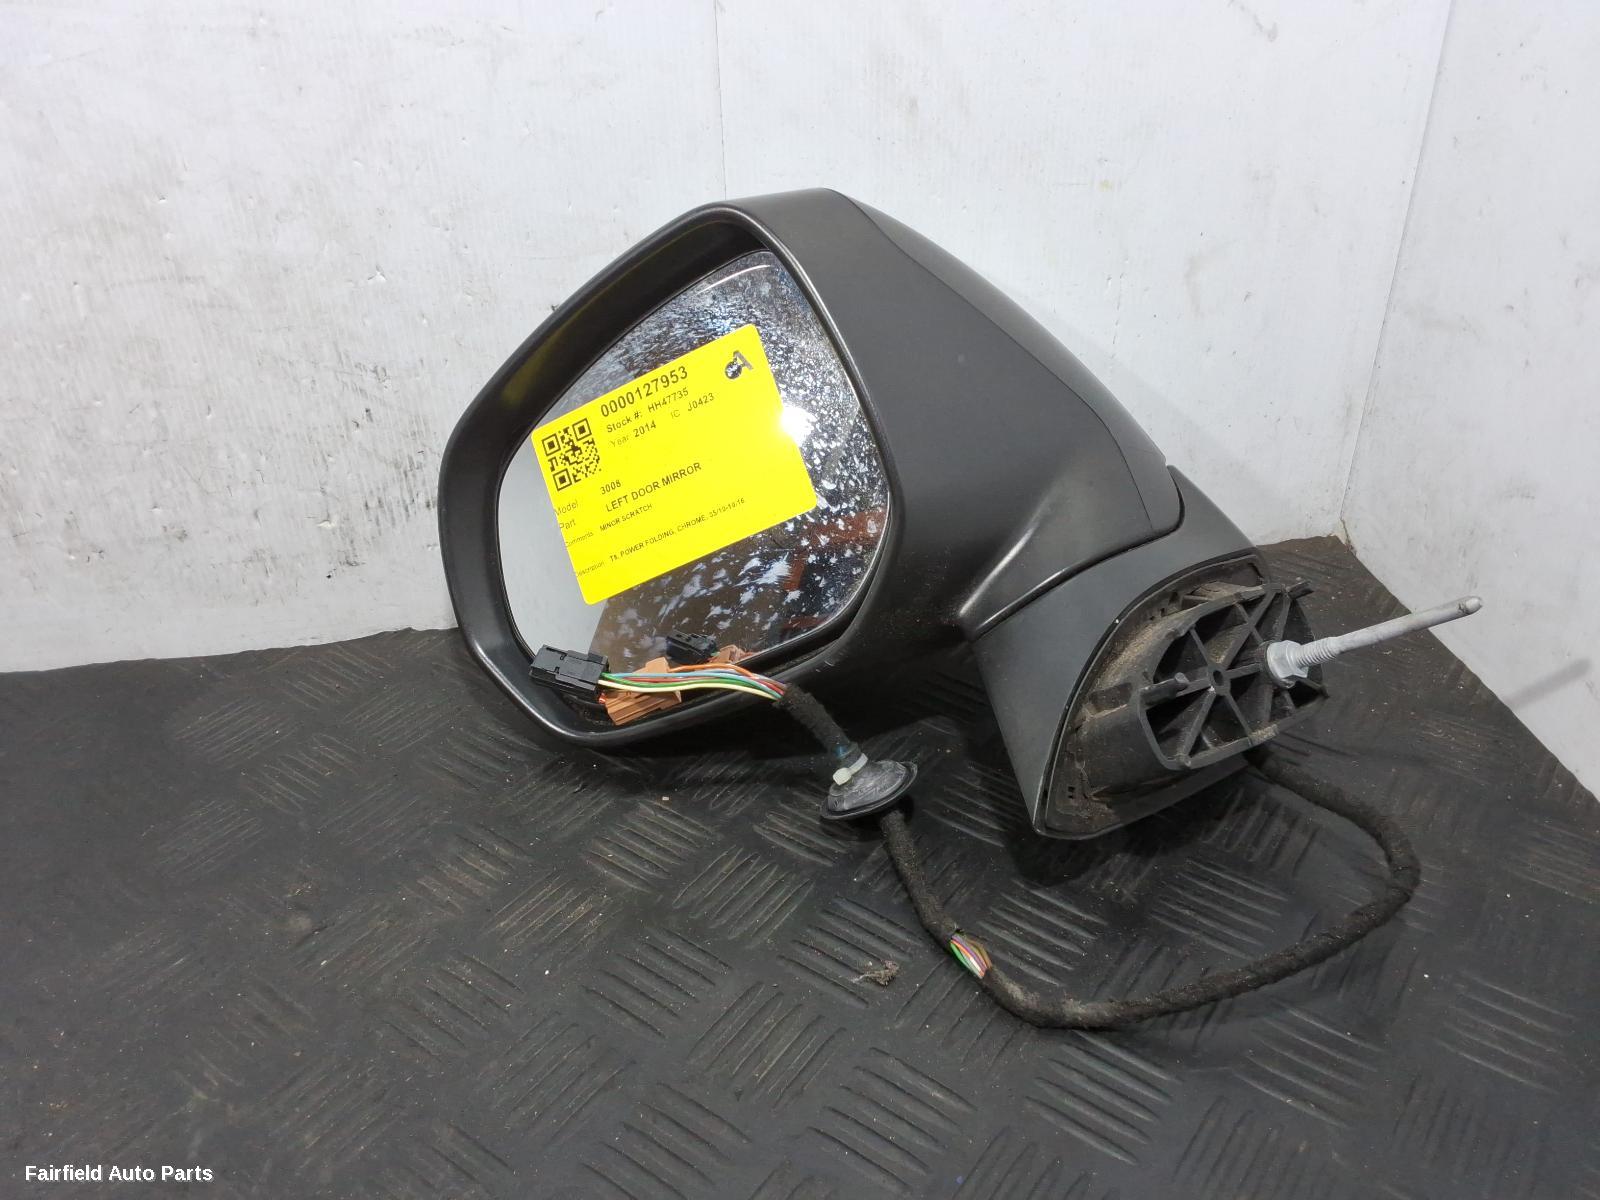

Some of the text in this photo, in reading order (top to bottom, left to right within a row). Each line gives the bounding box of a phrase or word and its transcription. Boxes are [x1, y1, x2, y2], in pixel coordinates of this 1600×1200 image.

[600, 366, 688, 417] 0000127953
[606, 416, 632, 433] Stock
[647, 387, 689, 413] HH47735
[633, 420, 657, 438] 2014
[687, 392, 715, 412] J0423
[600, 479, 622, 495] 3008
[606, 494, 629, 512] LEFT
[631, 481, 660, 500] DOOR
[661, 462, 702, 487] MIRROR
[599, 517, 621, 532] MINOR
[622, 503, 653, 522] SCRATCH
[620, 542, 644, 558] POWER
